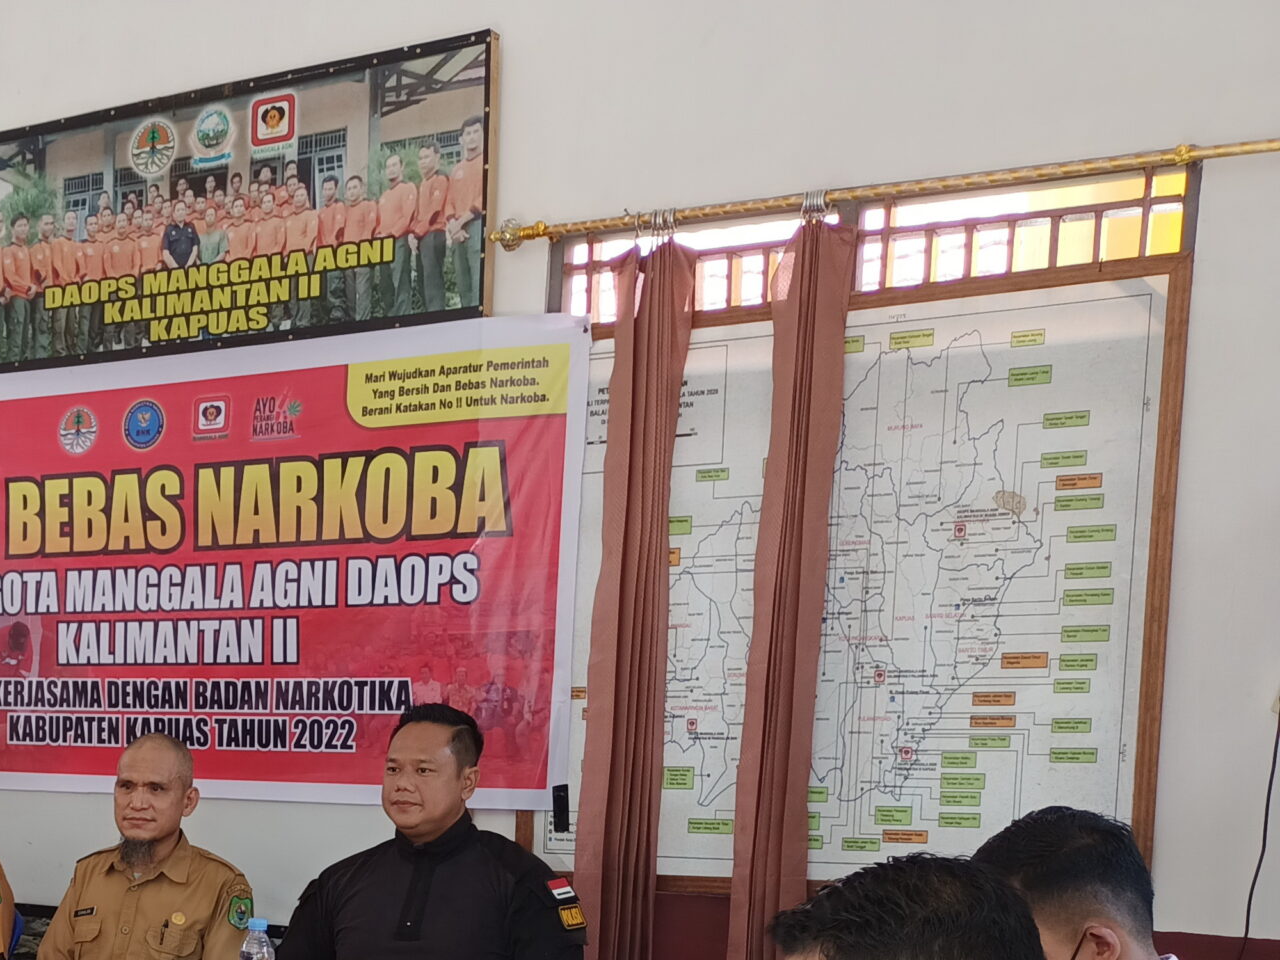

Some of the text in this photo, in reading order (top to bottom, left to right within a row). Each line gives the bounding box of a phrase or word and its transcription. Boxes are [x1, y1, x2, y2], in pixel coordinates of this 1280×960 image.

[44, 236, 395, 309] DAOPS MANGGALA AGNI
[103, 273, 321, 324] KALIMANTAN II
[149, 306, 269, 342] KAPUAS
[365, 356, 549, 384] Mari Wujudkan Aparatur Pemerintah
[372, 375, 539, 401] Yang Bersih Dan Bebas Narkoba.
[255, 396, 276, 413] AYO
[361, 404, 393, 417] Berani
[395, 400, 436, 414] Katakan
[439, 398, 453, 409] No
[465, 394, 497, 407] Untuk
[500, 392, 550, 406] Narkoba.
[252, 421, 294, 437] NARKOBA
[5, 465, 185, 557] BEBAS
[195, 442, 513, 550] NARKOBA
[64, 562, 251, 613] MANGGALA
[249, 558, 339, 609] AGNI
[344, 551, 480, 607] DAOPS
[56, 615, 300, 666] KALIMANTAN II
[106, 678, 191, 711] DENGAN
[193, 679, 269, 712] BADAN
[272, 678, 414, 714] NARKOTIKA
[6, 712, 120, 745] KABUPATEN
[215, 717, 290, 750] TAHUN
[291, 717, 357, 752] 2022
